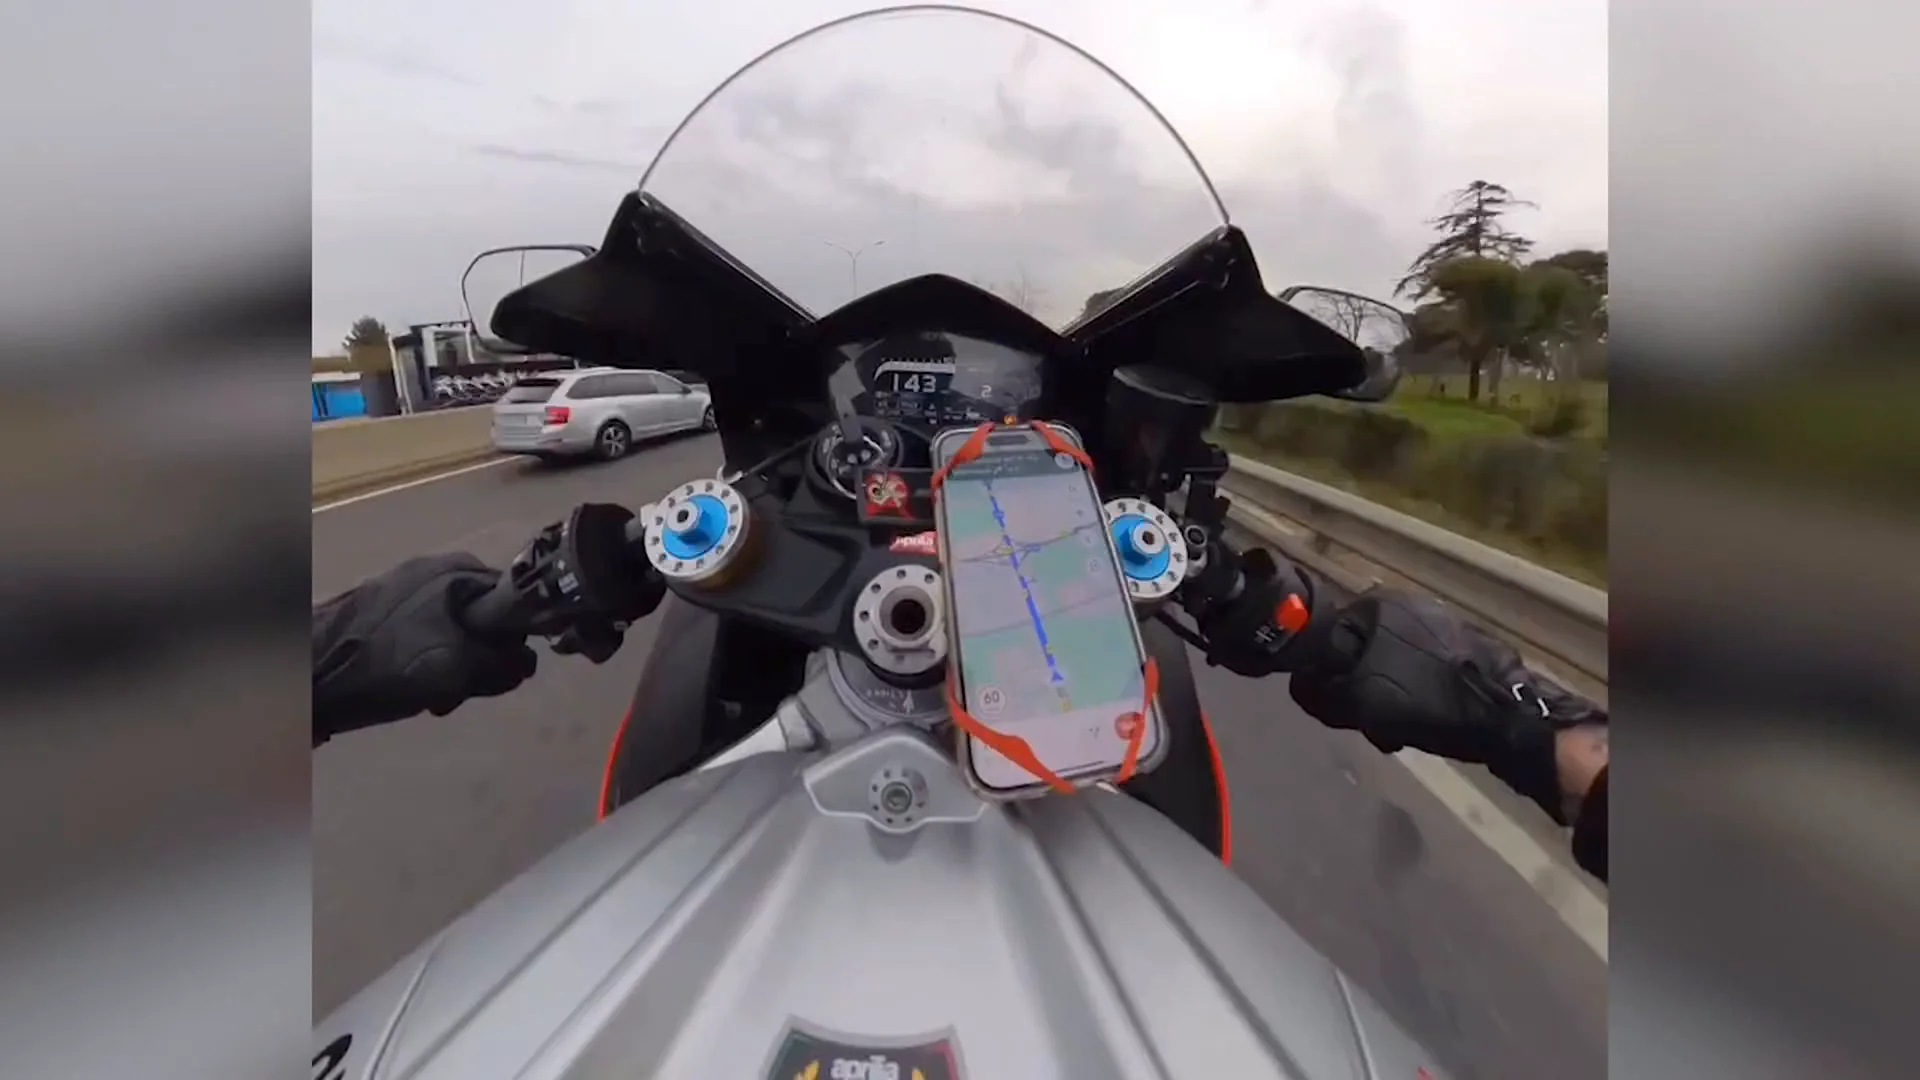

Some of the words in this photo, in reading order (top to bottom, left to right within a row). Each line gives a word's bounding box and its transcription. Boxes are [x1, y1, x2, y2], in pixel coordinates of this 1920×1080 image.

[893, 373, 937, 393] 143
[981, 385, 992, 398] 2
[984, 691, 1000, 704] 60
